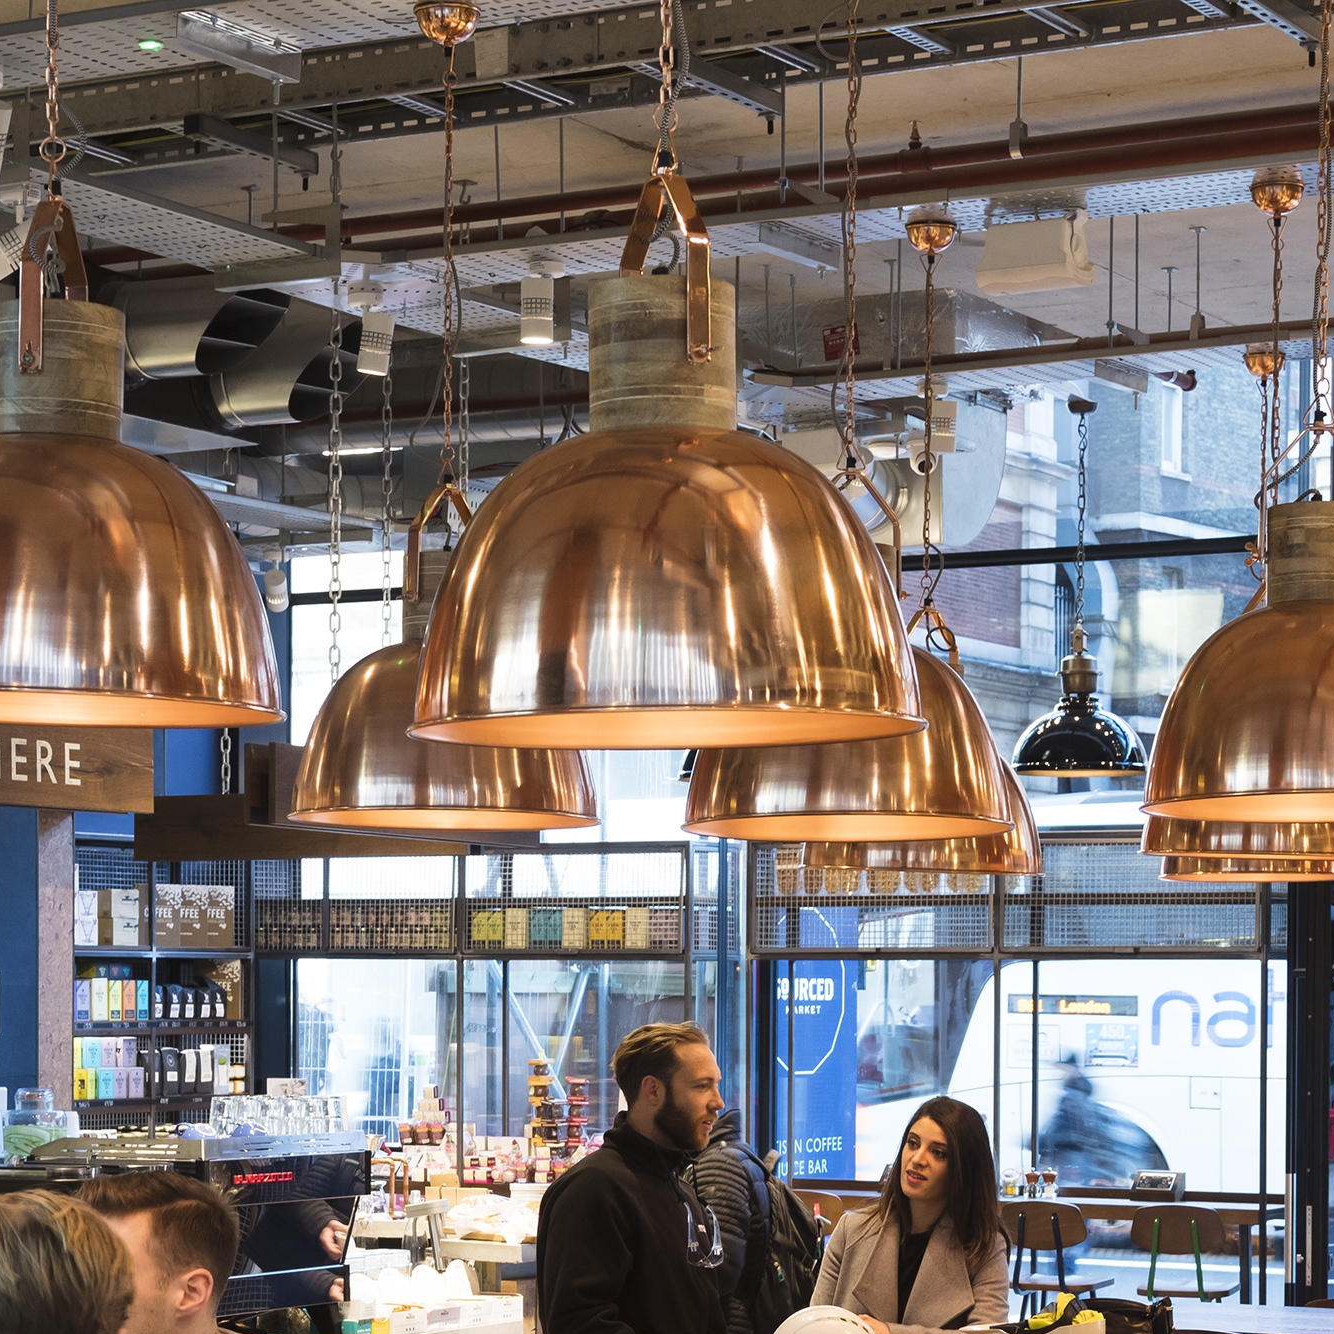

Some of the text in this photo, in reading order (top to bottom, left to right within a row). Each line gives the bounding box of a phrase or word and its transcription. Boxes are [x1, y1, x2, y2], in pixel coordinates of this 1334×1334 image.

[1059, 999, 1111, 1014] London
[1099, 1024, 1125, 1039] 450
[1013, 1048, 1055, 1056] WEMLEY
[806, 1136, 843, 1153] COFFEE
[808, 1159, 828, 1175] BAR
